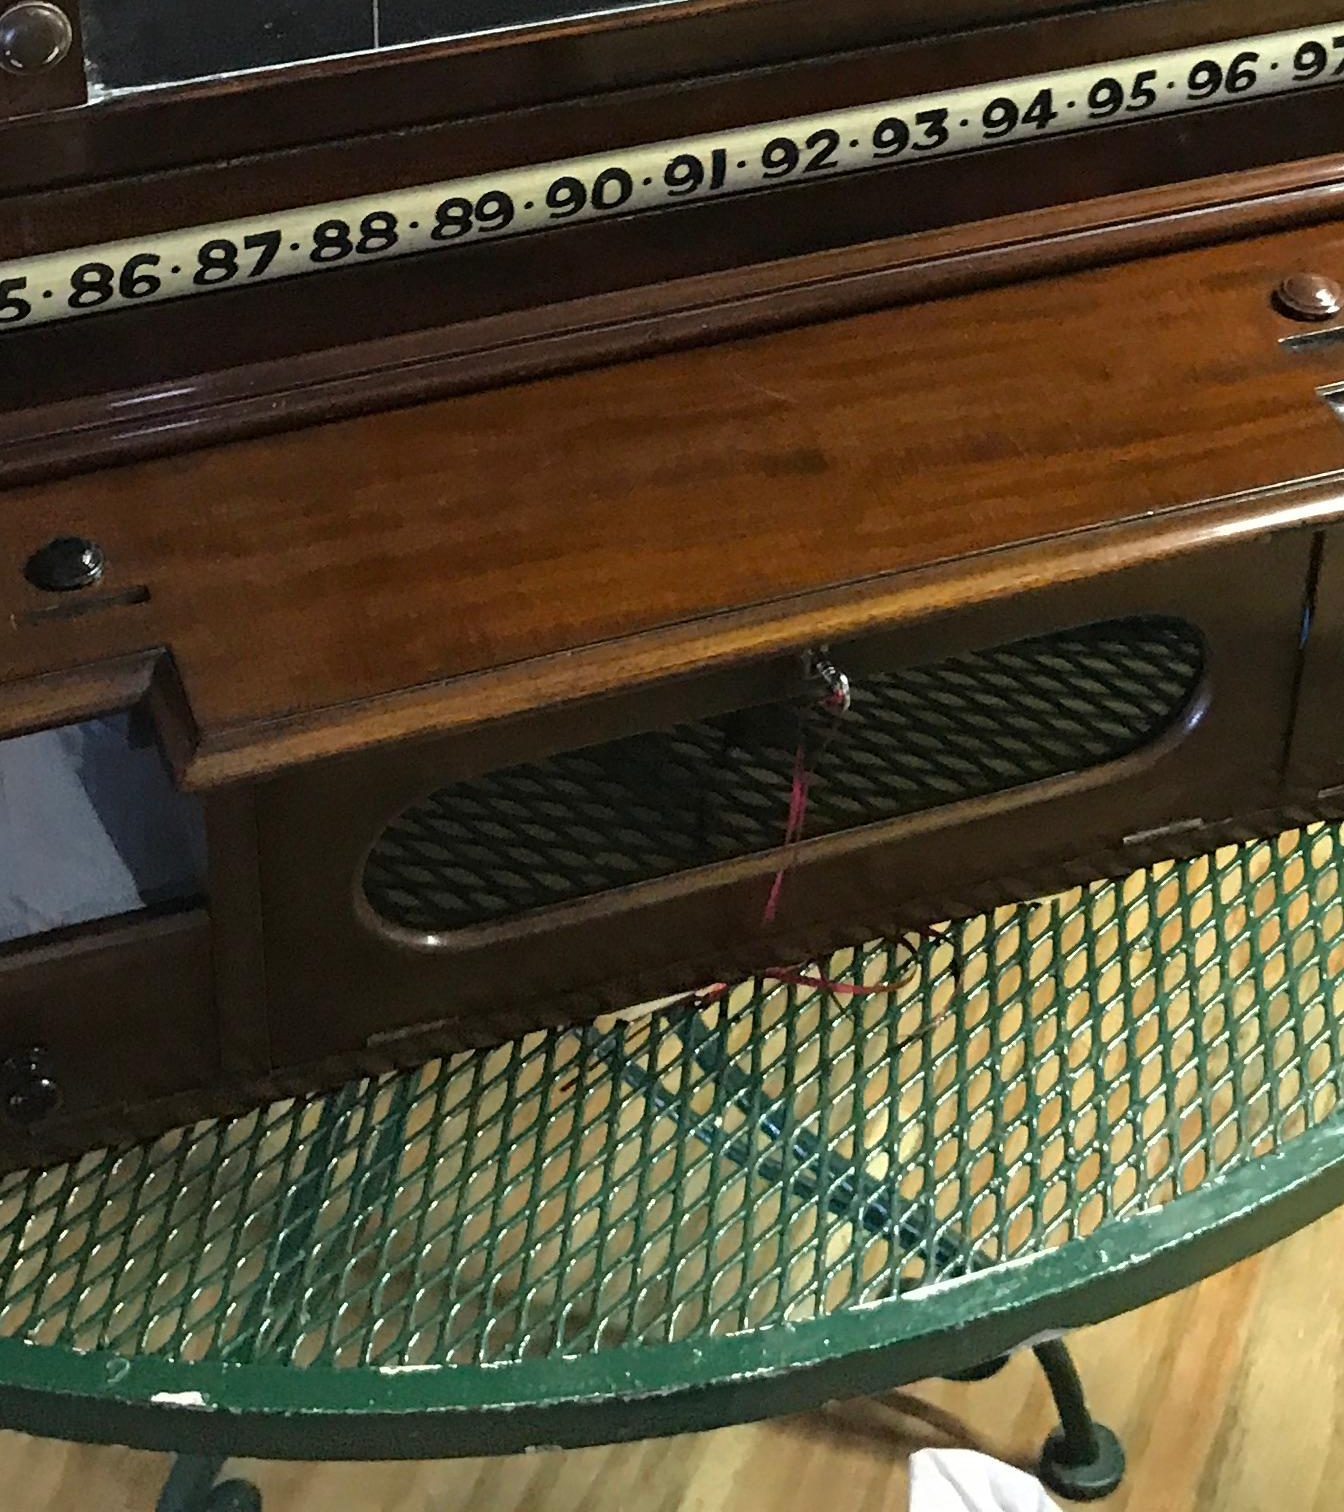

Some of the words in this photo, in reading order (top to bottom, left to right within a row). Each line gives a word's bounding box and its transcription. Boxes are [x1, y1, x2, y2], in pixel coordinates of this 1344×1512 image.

[67, 252, 163, 310] 86
[192, 229, 284, 287] 87
[309, 210, 401, 265] 88
[430, 189, 515, 244] 89
[545, 167, 634, 220] 90
[663, 148, 729, 198] 91
[761, 128, 841, 179] 92
[872, 107, 949, 159] 93
[981, 88, 1058, 139] 94
[1087, 69, 1156, 119] 95
[1186, 51, 1260, 101] 96
